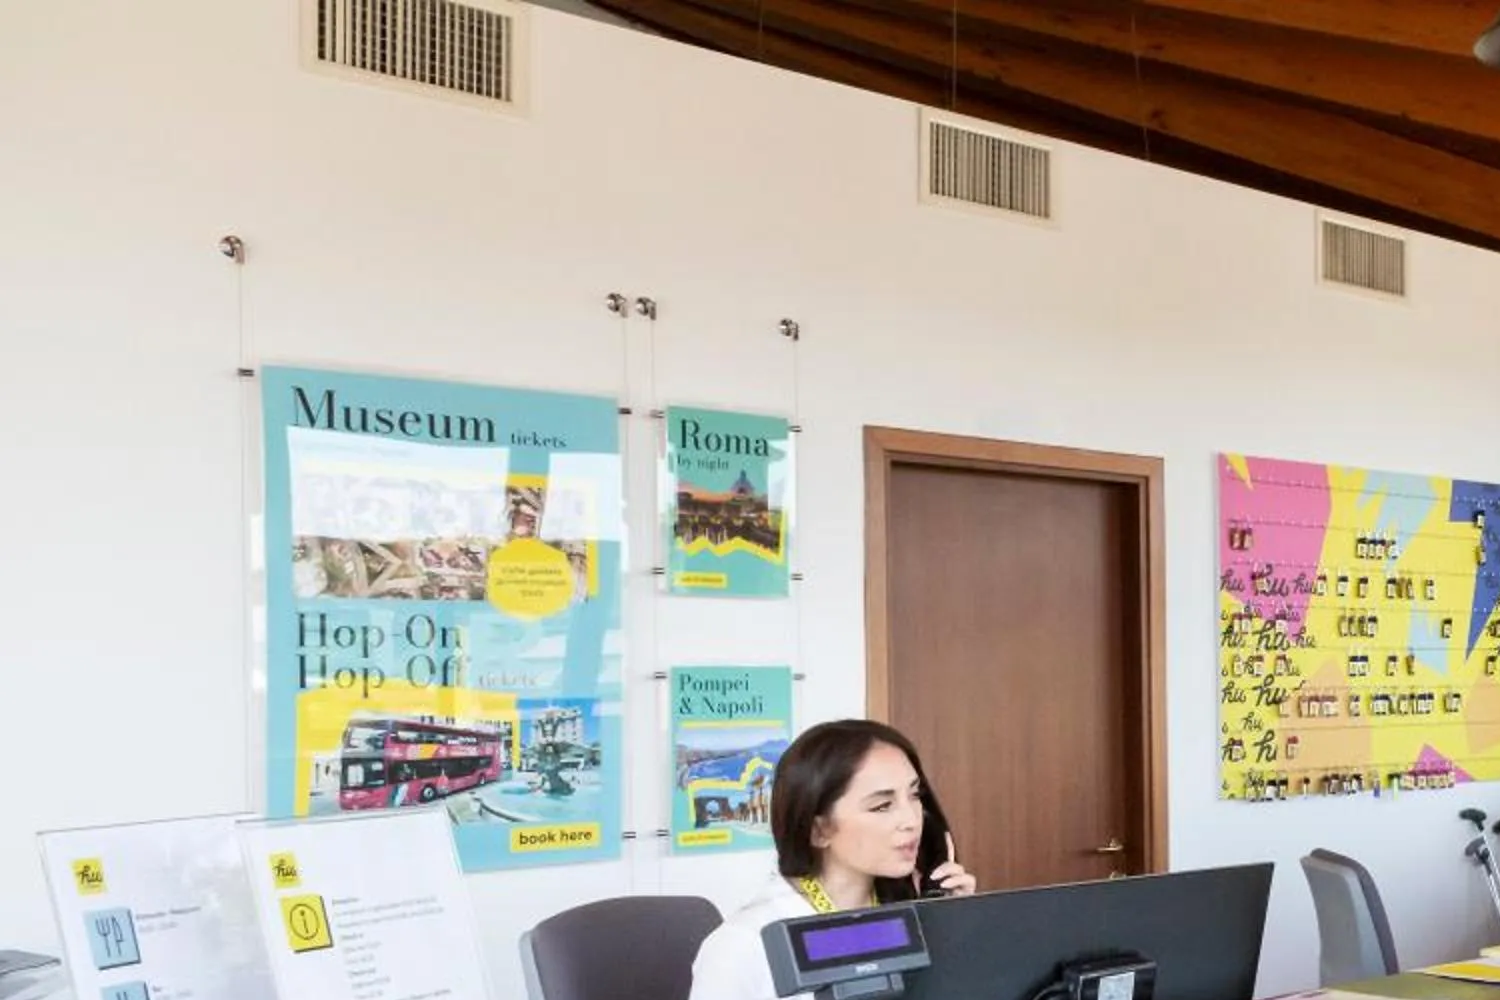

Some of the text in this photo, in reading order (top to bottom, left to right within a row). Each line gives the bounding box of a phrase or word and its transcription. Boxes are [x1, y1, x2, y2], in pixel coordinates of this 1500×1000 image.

[291, 384, 568, 448] Museum tickets
[680, 418, 770, 457] Roma
[697, 457, 730, 472] night
[296, 653, 386, 699] Hop
[679, 672, 750, 695] Pompei
[679, 695, 764, 718] & Napoli
[519, 828, 593, 845] book here
